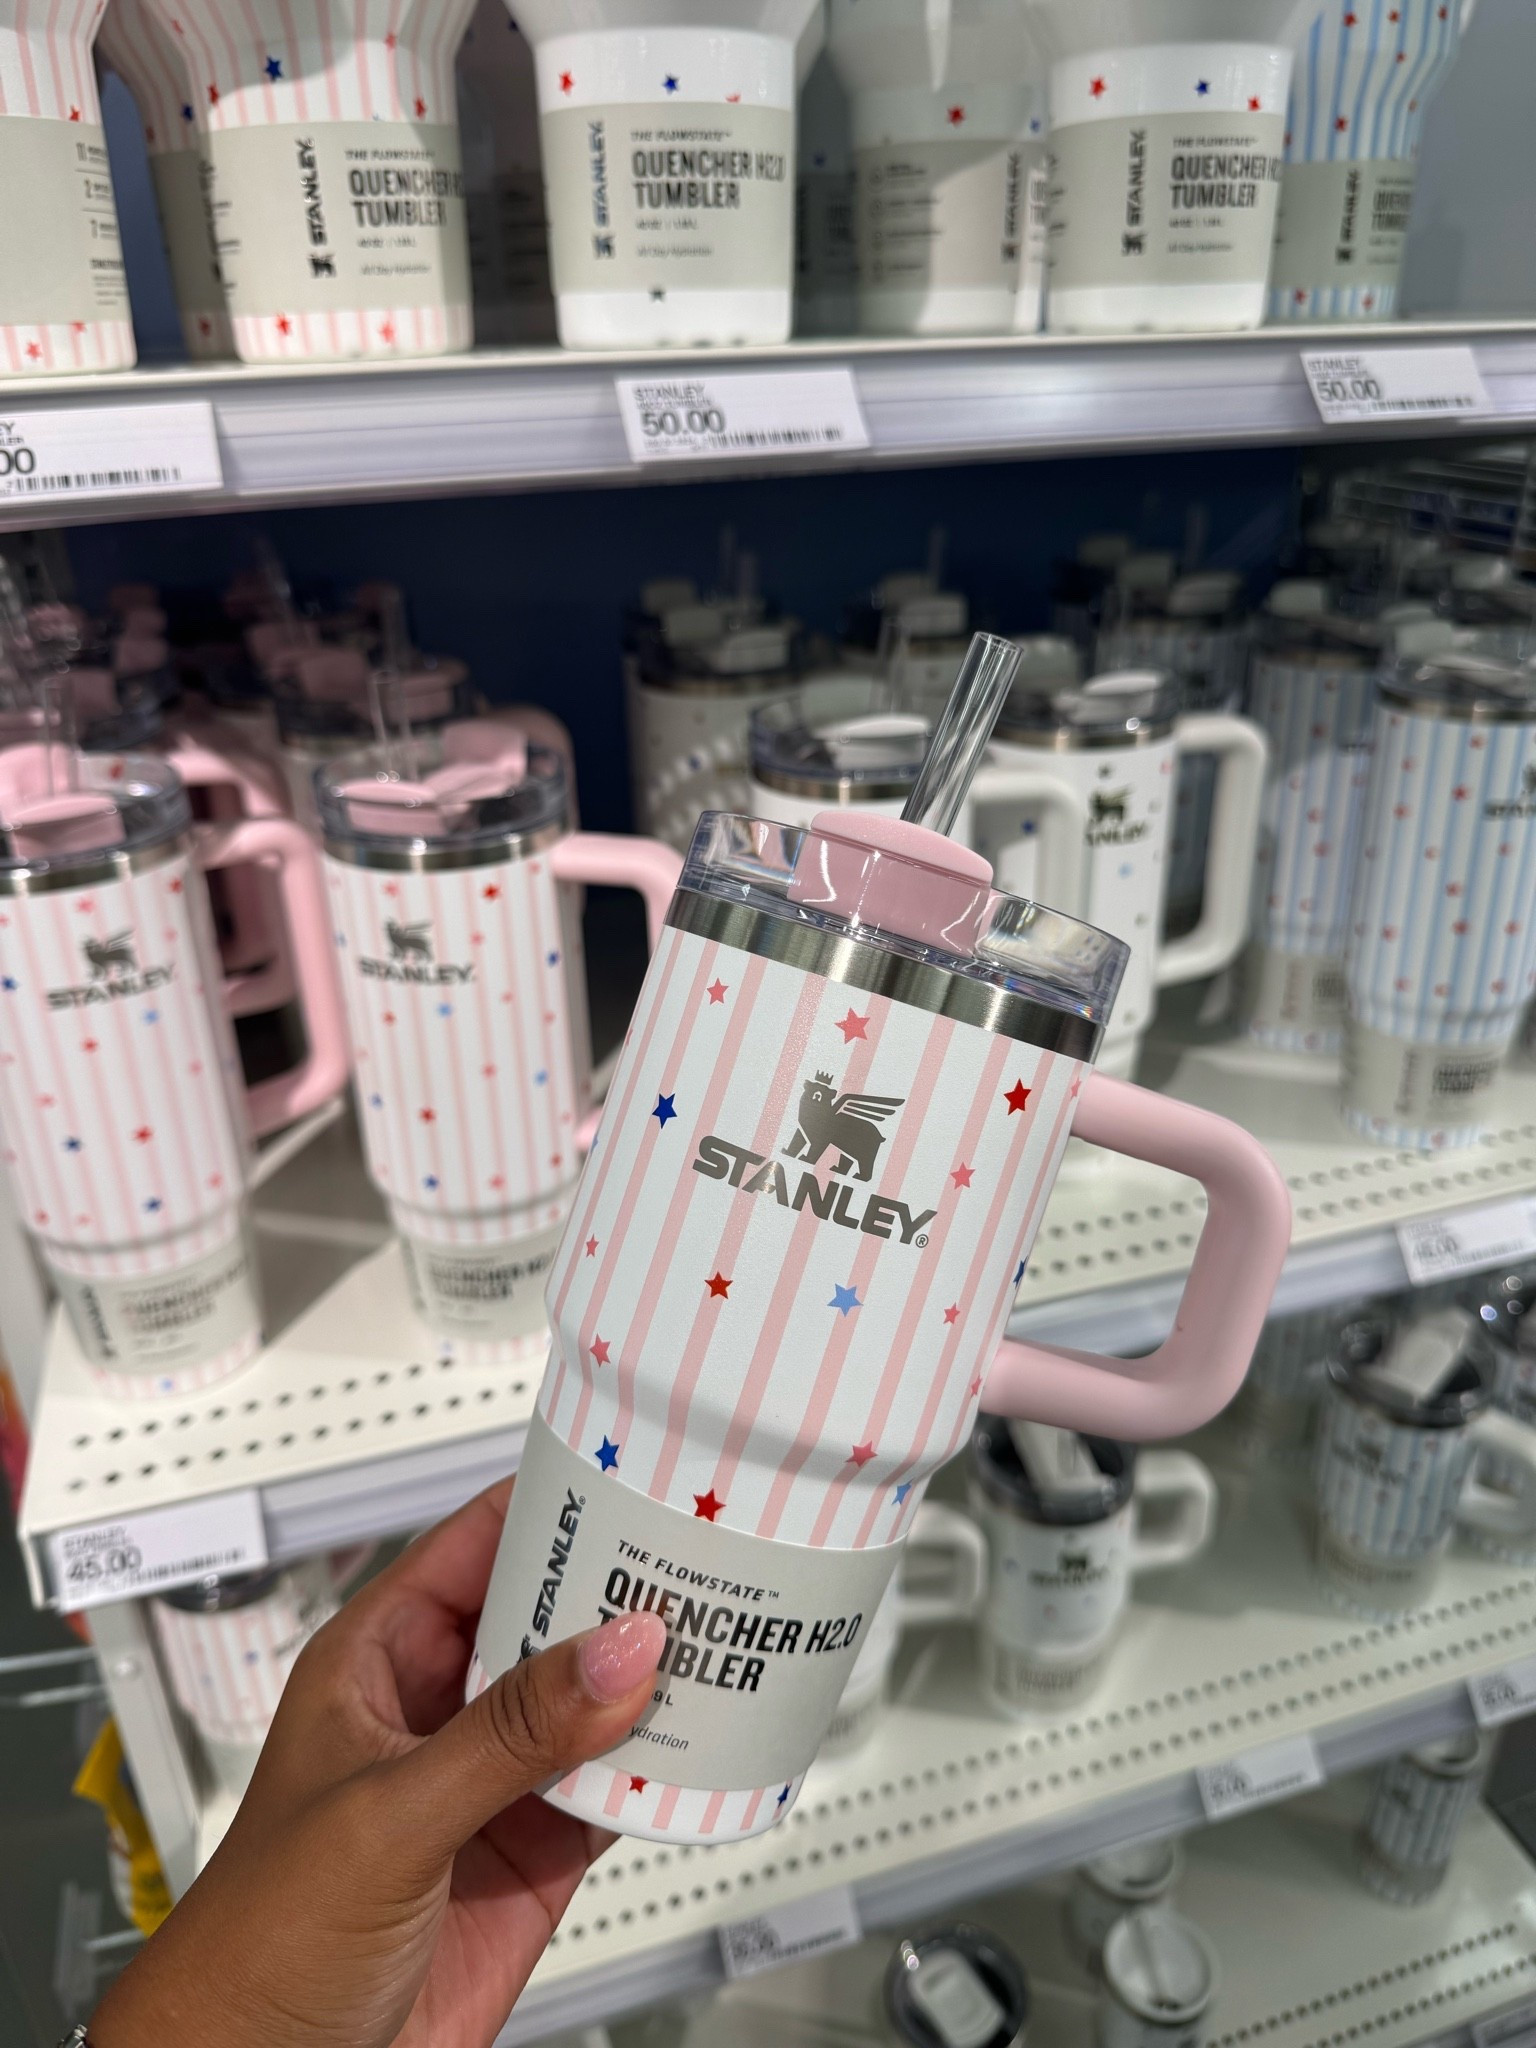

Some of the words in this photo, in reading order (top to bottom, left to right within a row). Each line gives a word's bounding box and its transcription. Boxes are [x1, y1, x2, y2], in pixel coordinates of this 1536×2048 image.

[632, 150, 752, 180] QUENCHER
[1171, 155, 1267, 182] QUENCHER
[632, 180, 742, 210] TUMBLER
[1169, 182, 1257, 210] TUMBLER
[352, 199, 448, 229] TUMBLER
[1317, 379, 1382, 403] 50.00
[641, 408, 727, 437] 50.00
[66, 1544, 143, 1581] 45.00
[617, 1539, 652, 1565] THE
[604, 1566, 804, 1655] QUENCHER
[804, 1612, 863, 1654] H2.0
